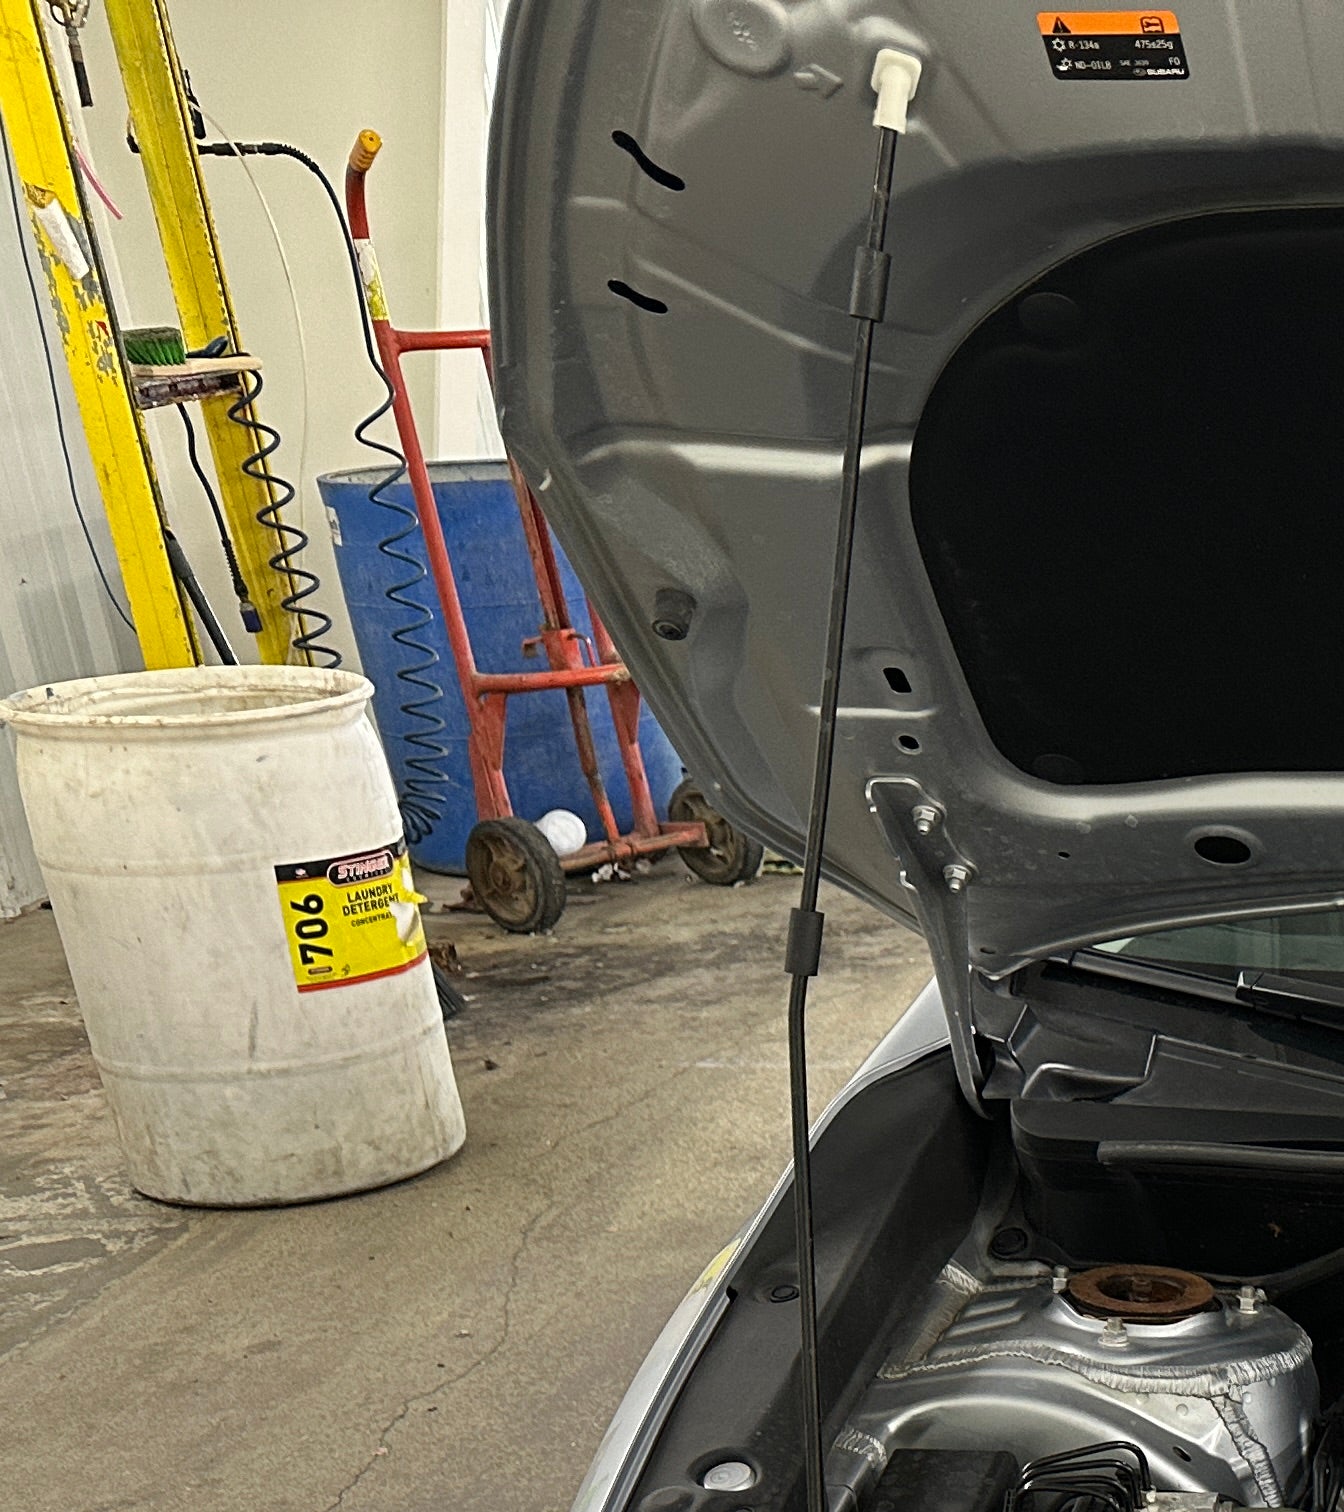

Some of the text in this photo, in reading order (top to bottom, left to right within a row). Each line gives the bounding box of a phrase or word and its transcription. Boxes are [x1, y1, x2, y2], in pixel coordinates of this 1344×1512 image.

[341, 892, 400, 917] DETERGENT
[346, 884, 394, 904] LAUNDRY
[290, 893, 334, 967] 706
